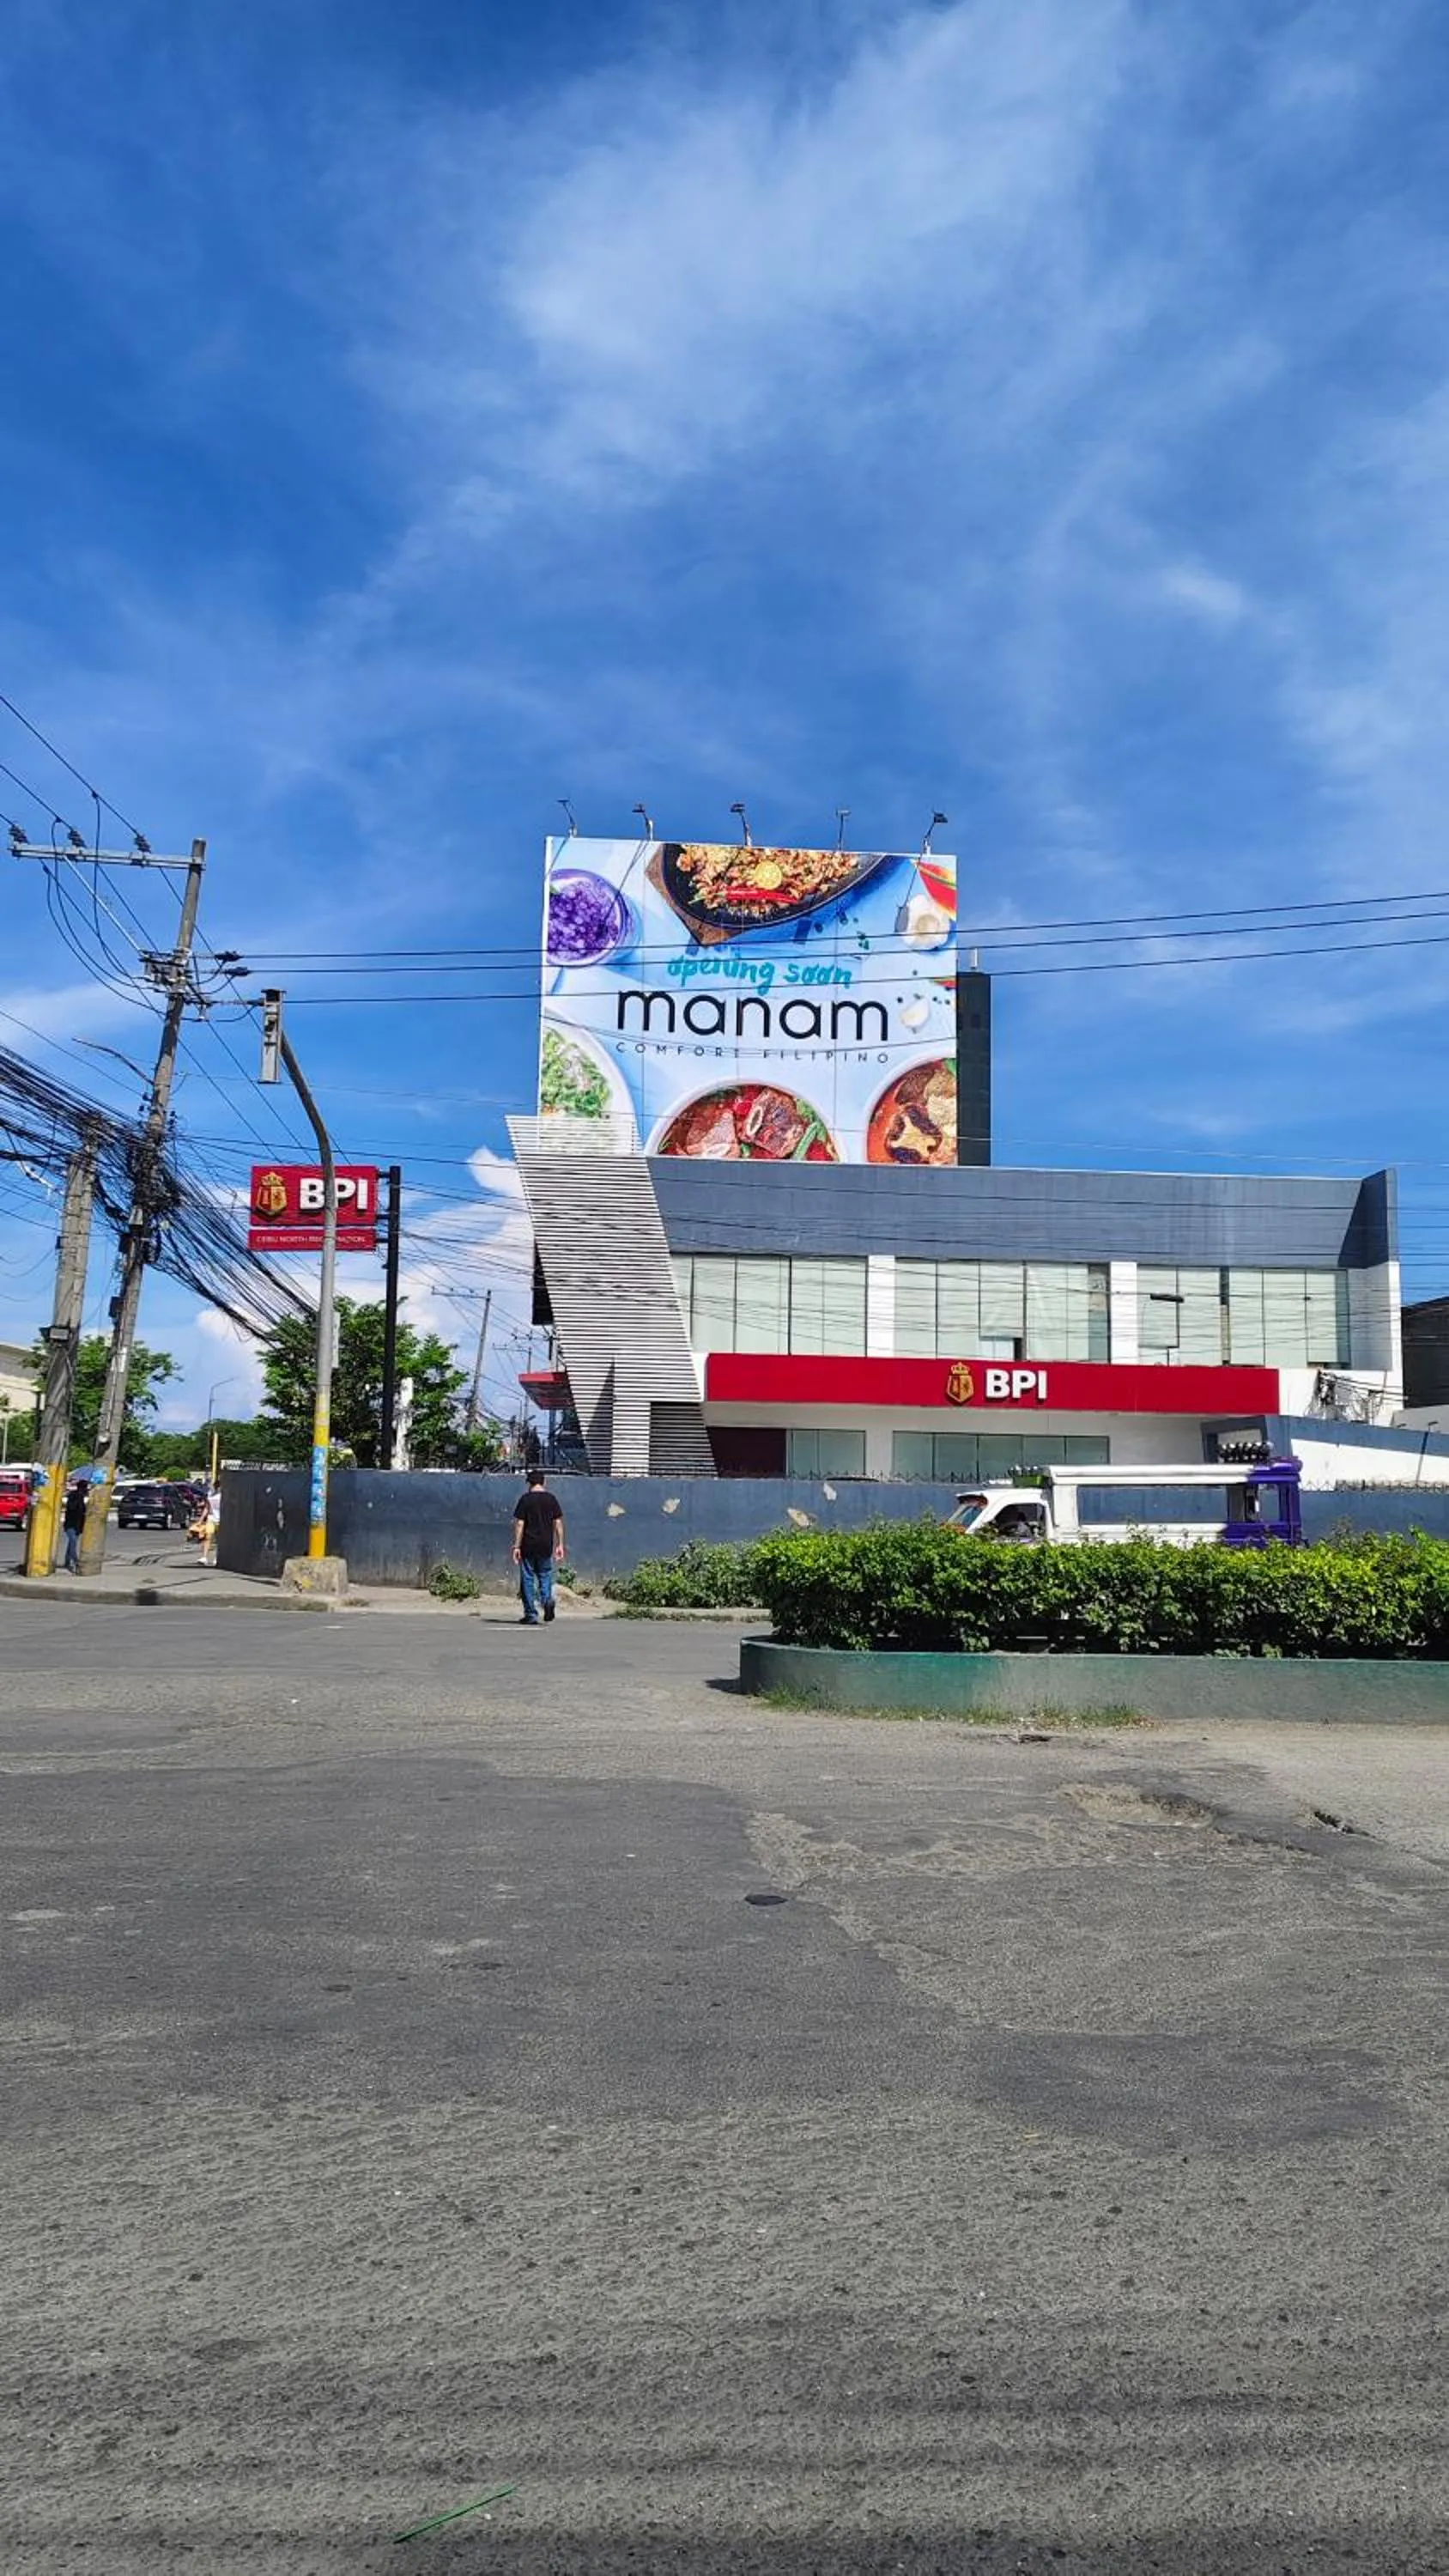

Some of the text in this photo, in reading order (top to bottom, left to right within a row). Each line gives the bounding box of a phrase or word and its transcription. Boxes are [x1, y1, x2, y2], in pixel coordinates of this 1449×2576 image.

[668, 952, 852, 997] opening soon
[617, 990, 888, 1042] manam
[615, 1042, 888, 1064] COMFORT FILIPINO
[300, 1177, 369, 1211] BPI
[985, 1369, 1047, 1400] BPI
